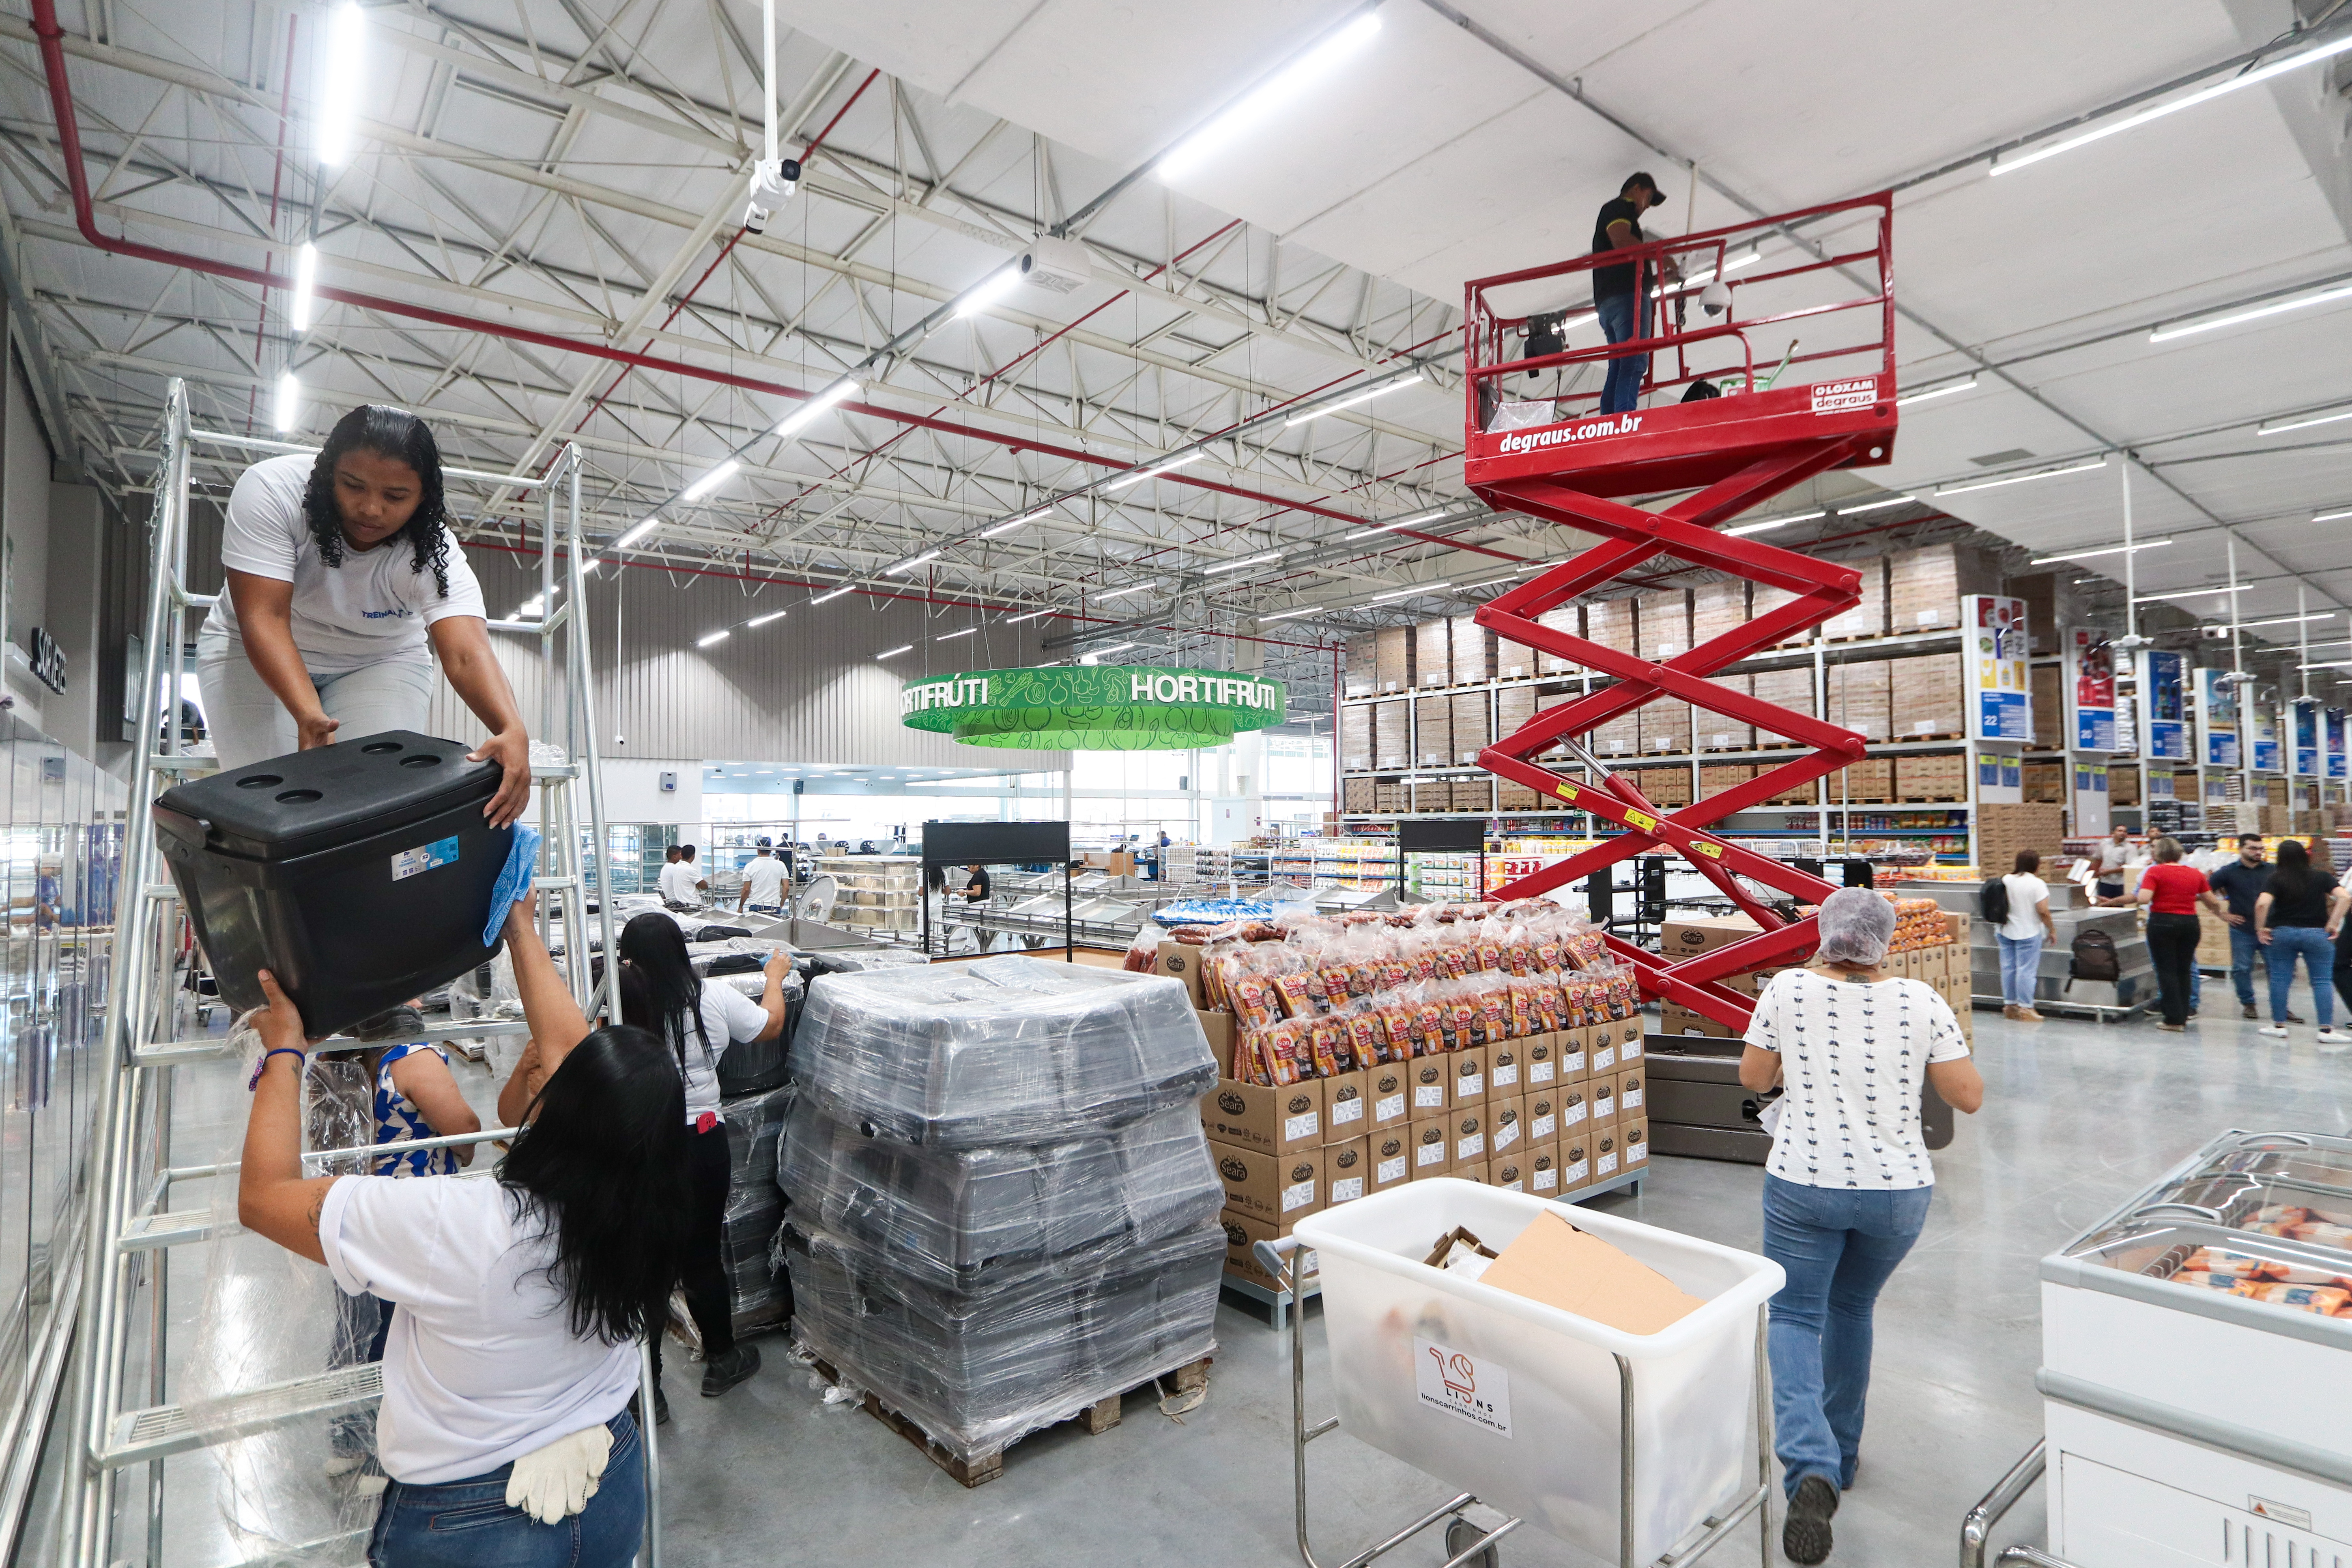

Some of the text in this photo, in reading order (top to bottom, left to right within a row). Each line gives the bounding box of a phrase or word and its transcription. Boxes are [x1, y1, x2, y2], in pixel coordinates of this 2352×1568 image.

[1817, 394, 1873, 409] degraus
[1500, 413, 1643, 453] degraus.com.br
[900, 673, 988, 716] ORTIFRÚTI
[1131, 674, 1275, 710] HORTIFRÚTI
[1984, 715, 1998, 726] 22
[1683, 934, 1703, 943] Seara
[1167, 960, 1184, 969] Seara
[1326, 975, 1344, 984] Seara
[1532, 1049, 1548, 1058] Seara
[1498, 1056, 1513, 1065] Seara
[1461, 1065, 1476, 1074] Seara
[1421, 1072, 1438, 1081] Seara
[1379, 1081, 1397, 1090] Seara
[1597, 1090, 1610, 1098] Seara
[1219, 1098, 1243, 1112] Seara
[1290, 1101, 1309, 1112] Seara
[1535, 1104, 1550, 1114] Seara
[1501, 1113, 1516, 1123] Seara
[1423, 1133, 1440, 1143] Seara
[1382, 1144, 1400, 1155] Seara
[1338, 1155, 1357, 1166] Seara
[1569, 1152, 1583, 1160] Seara
[1221, 1163, 1246, 1179] Seara
[1293, 1169, 1312, 1180] Seara
[1502, 1170, 1518, 1180] Seara
[1226, 1230, 1246, 1244] eara
[1446, 1387, 1494, 1413] LIONS
[1421, 1392, 1507, 1432] lionscarrinhos.com.br
[1449, 1399, 1492, 1419] CARRINHOS
